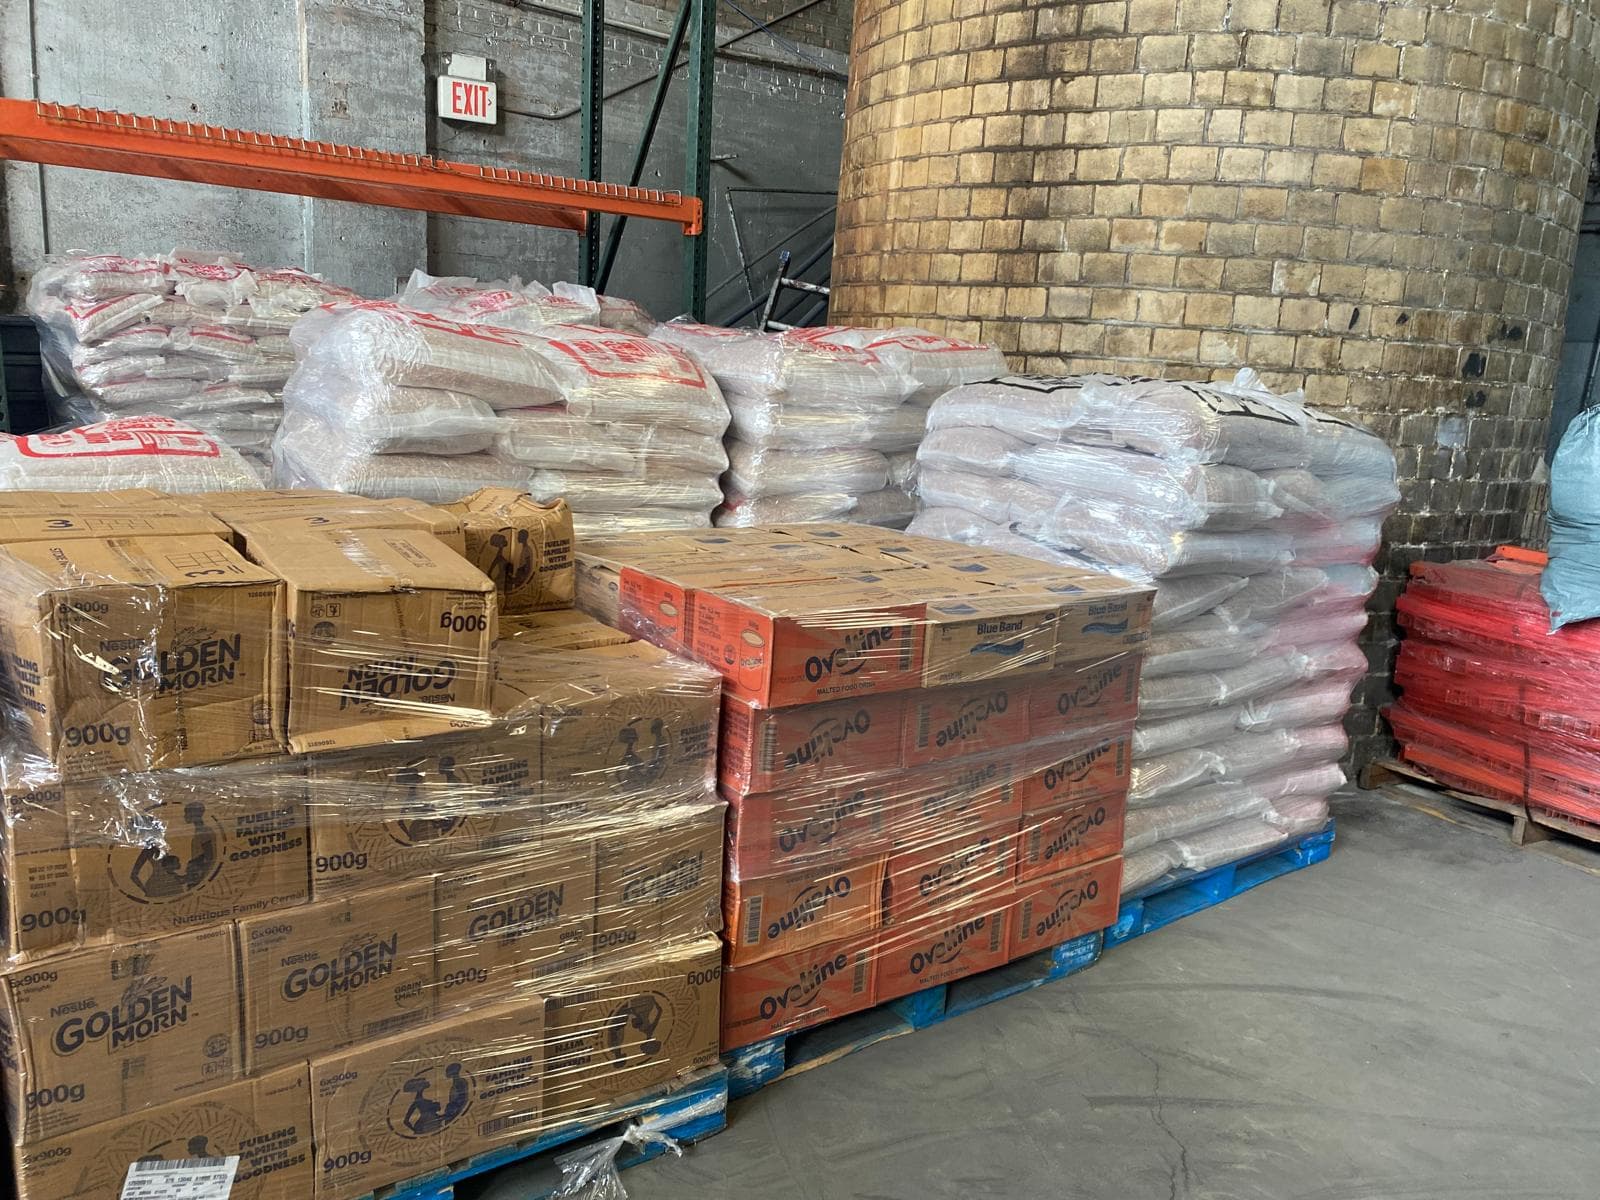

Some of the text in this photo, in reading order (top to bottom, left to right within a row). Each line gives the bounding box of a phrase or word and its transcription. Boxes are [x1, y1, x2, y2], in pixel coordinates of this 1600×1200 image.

[452, 81, 489, 117] EXIT
[549, 555, 566, 563] WITH
[1089, 600, 1127, 616] Blue Band
[440, 612, 487, 633] 900g
[977, 620, 1023, 635] Blue Band
[805, 626, 894, 682] Ovaltine
[157, 663, 235, 692] MORN
[340, 659, 459, 710] GOLDEN
[1057, 664, 1123, 715] Ovaltine
[936, 691, 1009, 747] Ovaltine
[66, 723, 131, 747] 900g
[784, 709, 870, 771] Ovaltine
[1044, 738, 1111, 790] Ovaltine
[248, 831, 286, 847] WITH
[1045, 807, 1106, 860] Ovaltine
[229, 837, 303, 862] GOODNESS
[315, 851, 368, 873] 900g
[20, 906, 86, 932] 900g
[173, 889, 305, 926] Nutritious Family Cereal
[467, 884, 565, 942] GOLDEN
[767, 876, 852, 939] Ovaltine
[1037, 880, 1099, 936] Ovaltine
[251, 924, 292, 940] 6x900g
[910, 917, 986, 974] Ovaltine
[284, 933, 398, 999] GOLDEN
[329, 960, 392, 997] MORN
[443, 967, 488, 988] 900g
[687, 966, 721, 986] 900g
[394, 981, 422, 994] GRAIN
[760, 953, 848, 1020] Ovaltine
[55, 976, 192, 1053] GOLDEN
[112, 1006, 187, 1048] MORN
[254, 1025, 309, 1049] 900g
[320, 1072, 358, 1086] 6x900g
[26, 1082, 85, 1110] 900g
[239, 1126, 295, 1150] FUELING
[239, 1136, 297, 1160] FAMILIES
[234, 1154, 305, 1183] GOODNESS
[250, 1150, 288, 1166] WITH
[324, 1150, 372, 1173] 900g
